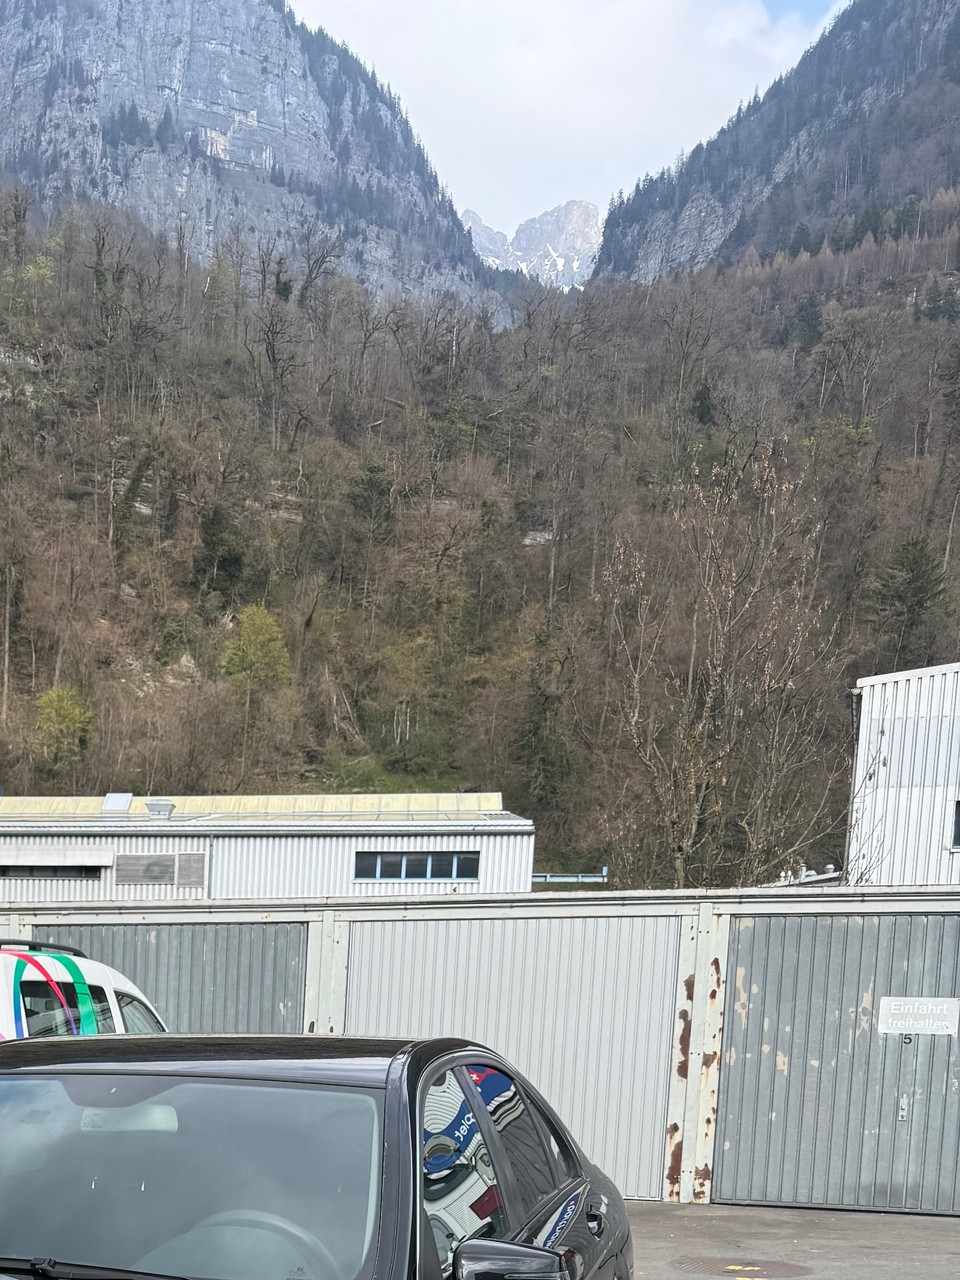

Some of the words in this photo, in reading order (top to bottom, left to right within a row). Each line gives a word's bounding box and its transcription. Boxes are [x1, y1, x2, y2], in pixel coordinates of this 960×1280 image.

[890, 1001, 949, 1015] Einfahrt
[888, 1018, 951, 1029] freihalten
[903, 1034, 913, 1045] 5
